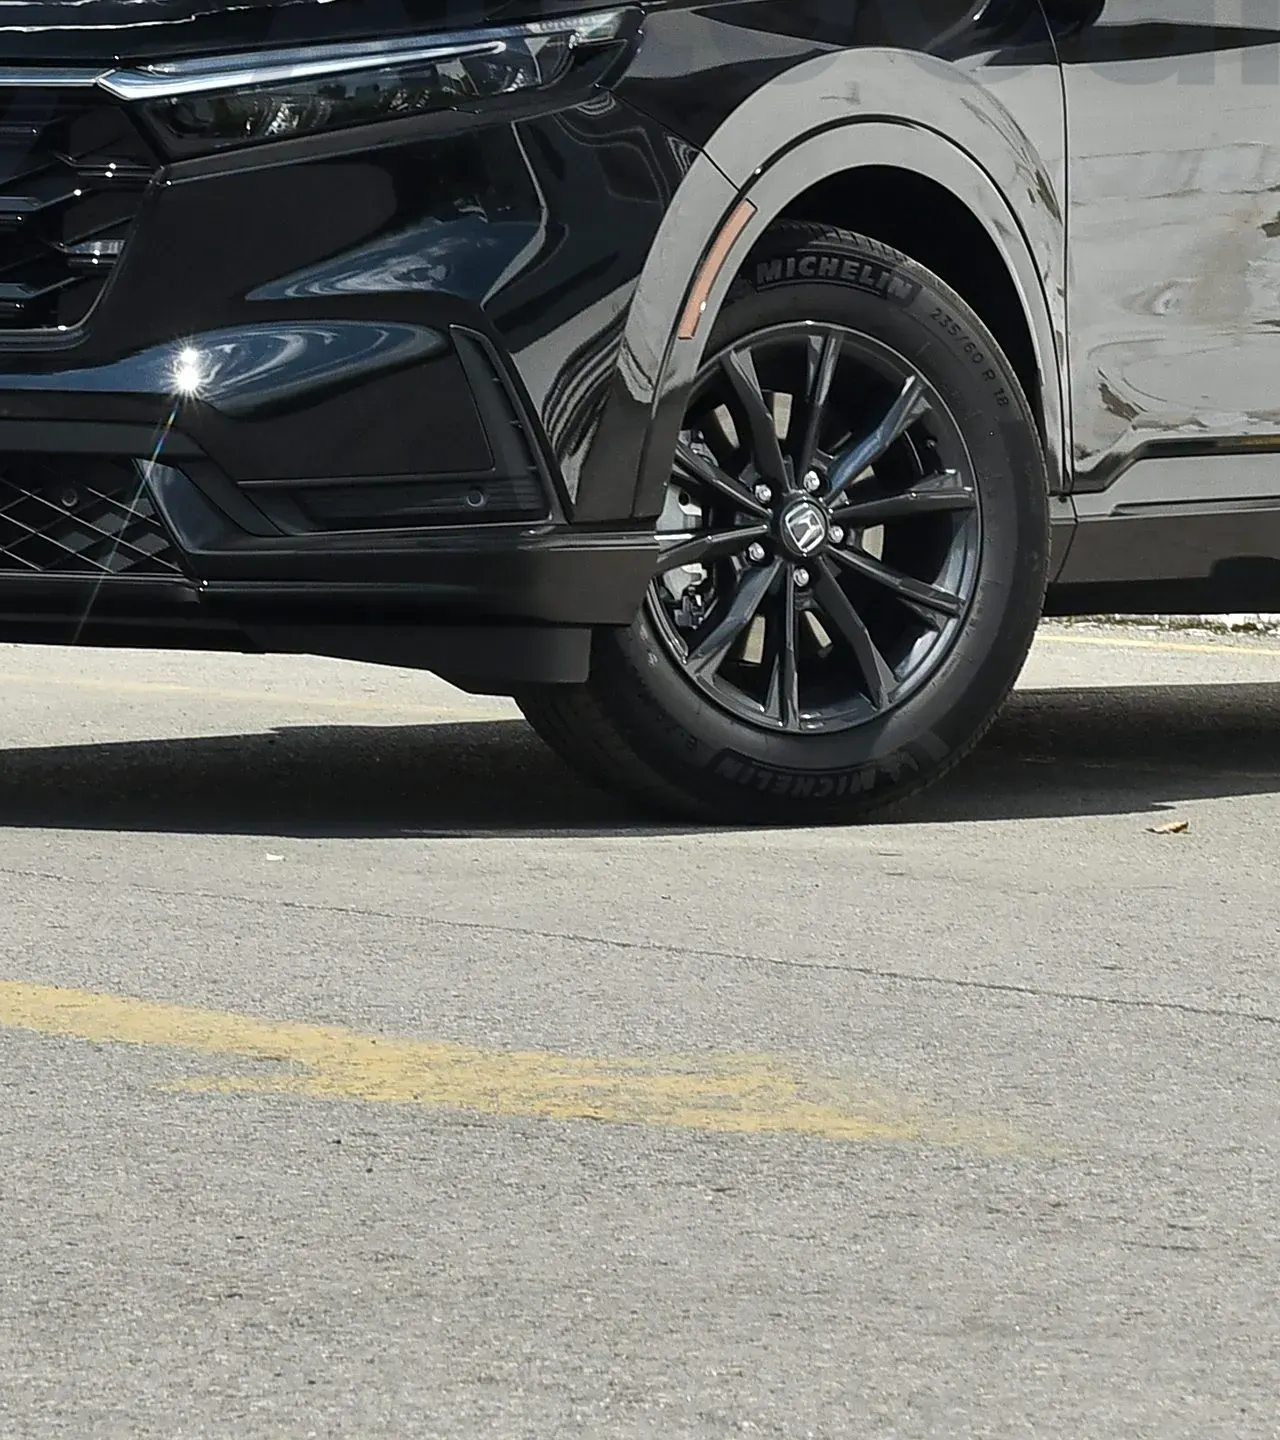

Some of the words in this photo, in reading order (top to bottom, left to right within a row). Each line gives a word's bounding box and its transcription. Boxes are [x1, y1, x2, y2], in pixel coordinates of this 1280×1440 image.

[755, 255, 914, 300] MICHELIN
[929, 307, 985, 365] 235/60
[982, 368, 997, 382] R
[991, 388, 1010, 408] 18
[714, 755, 878, 798] MICHELIN
